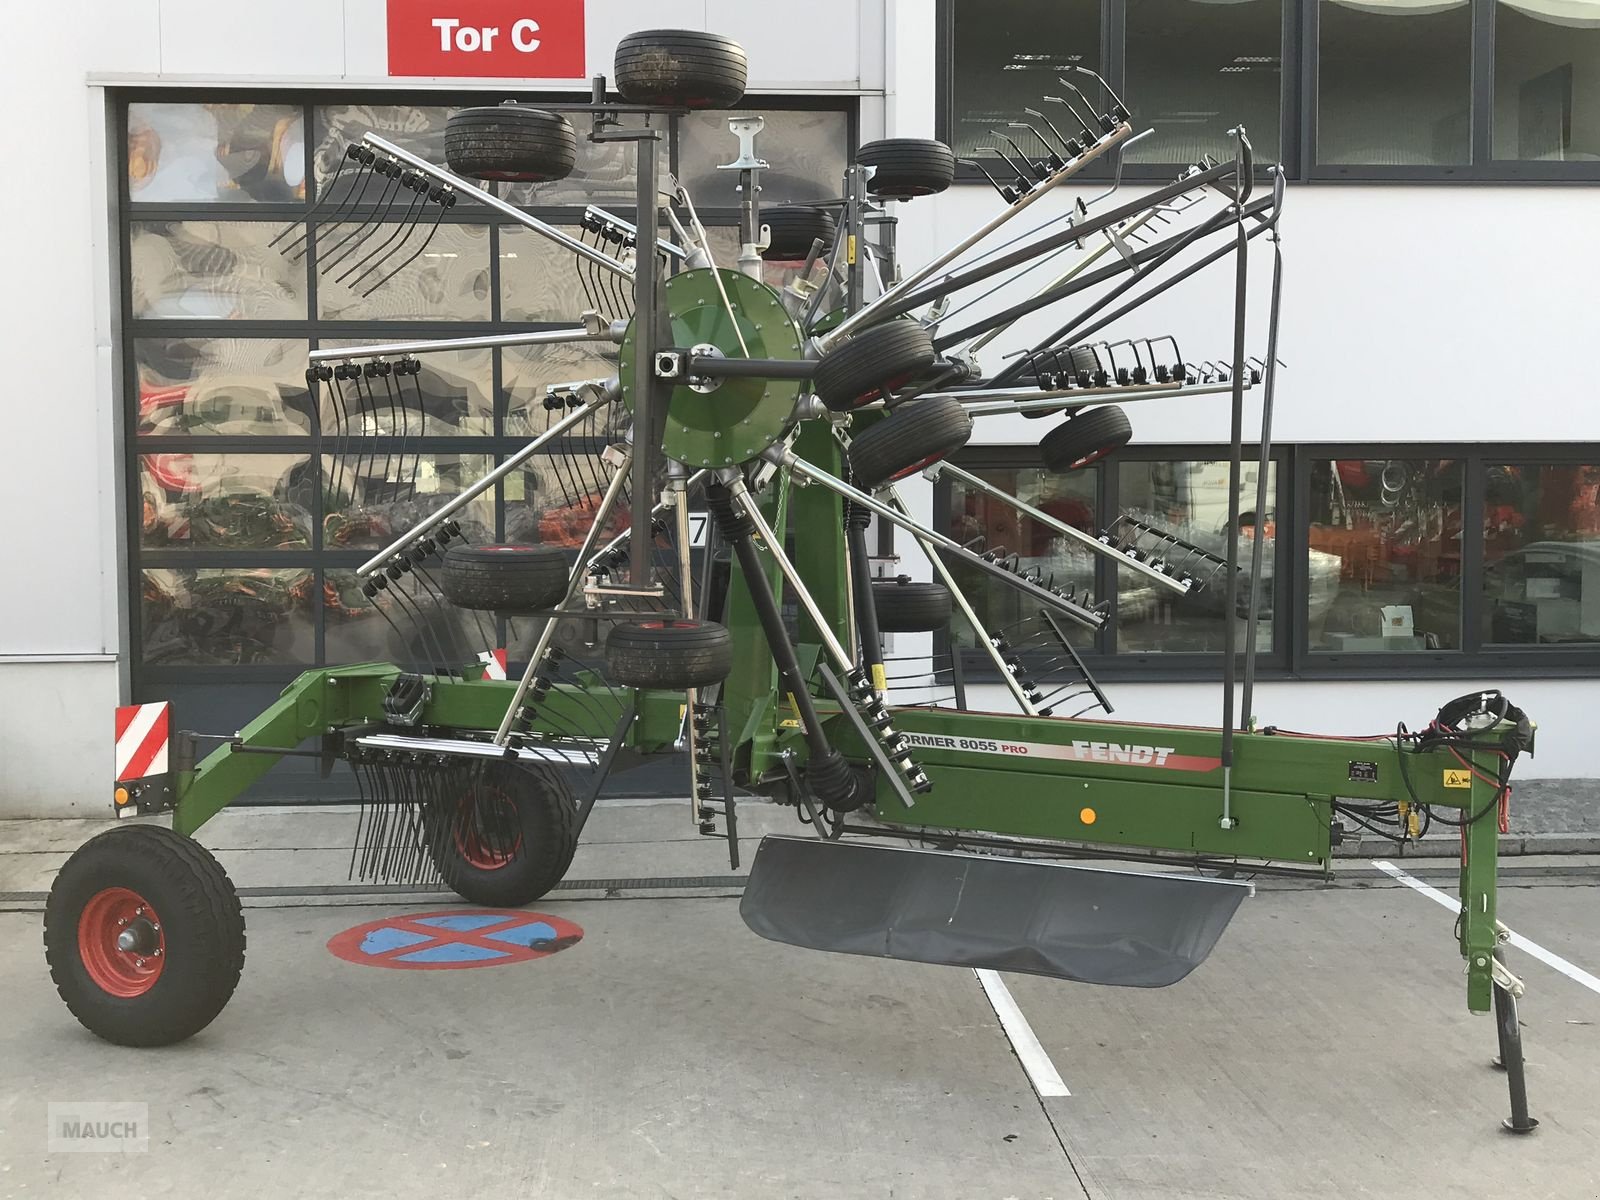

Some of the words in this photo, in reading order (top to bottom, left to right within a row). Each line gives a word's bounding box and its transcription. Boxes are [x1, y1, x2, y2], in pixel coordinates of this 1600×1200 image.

[431, 18, 499, 52] Tor
[511, 18, 541, 53] C
[689, 516, 707, 544] 7
[959, 739, 998, 752] 8055
[1001, 744, 1028, 755] PRO
[1071, 740, 1175, 766] FENDT
